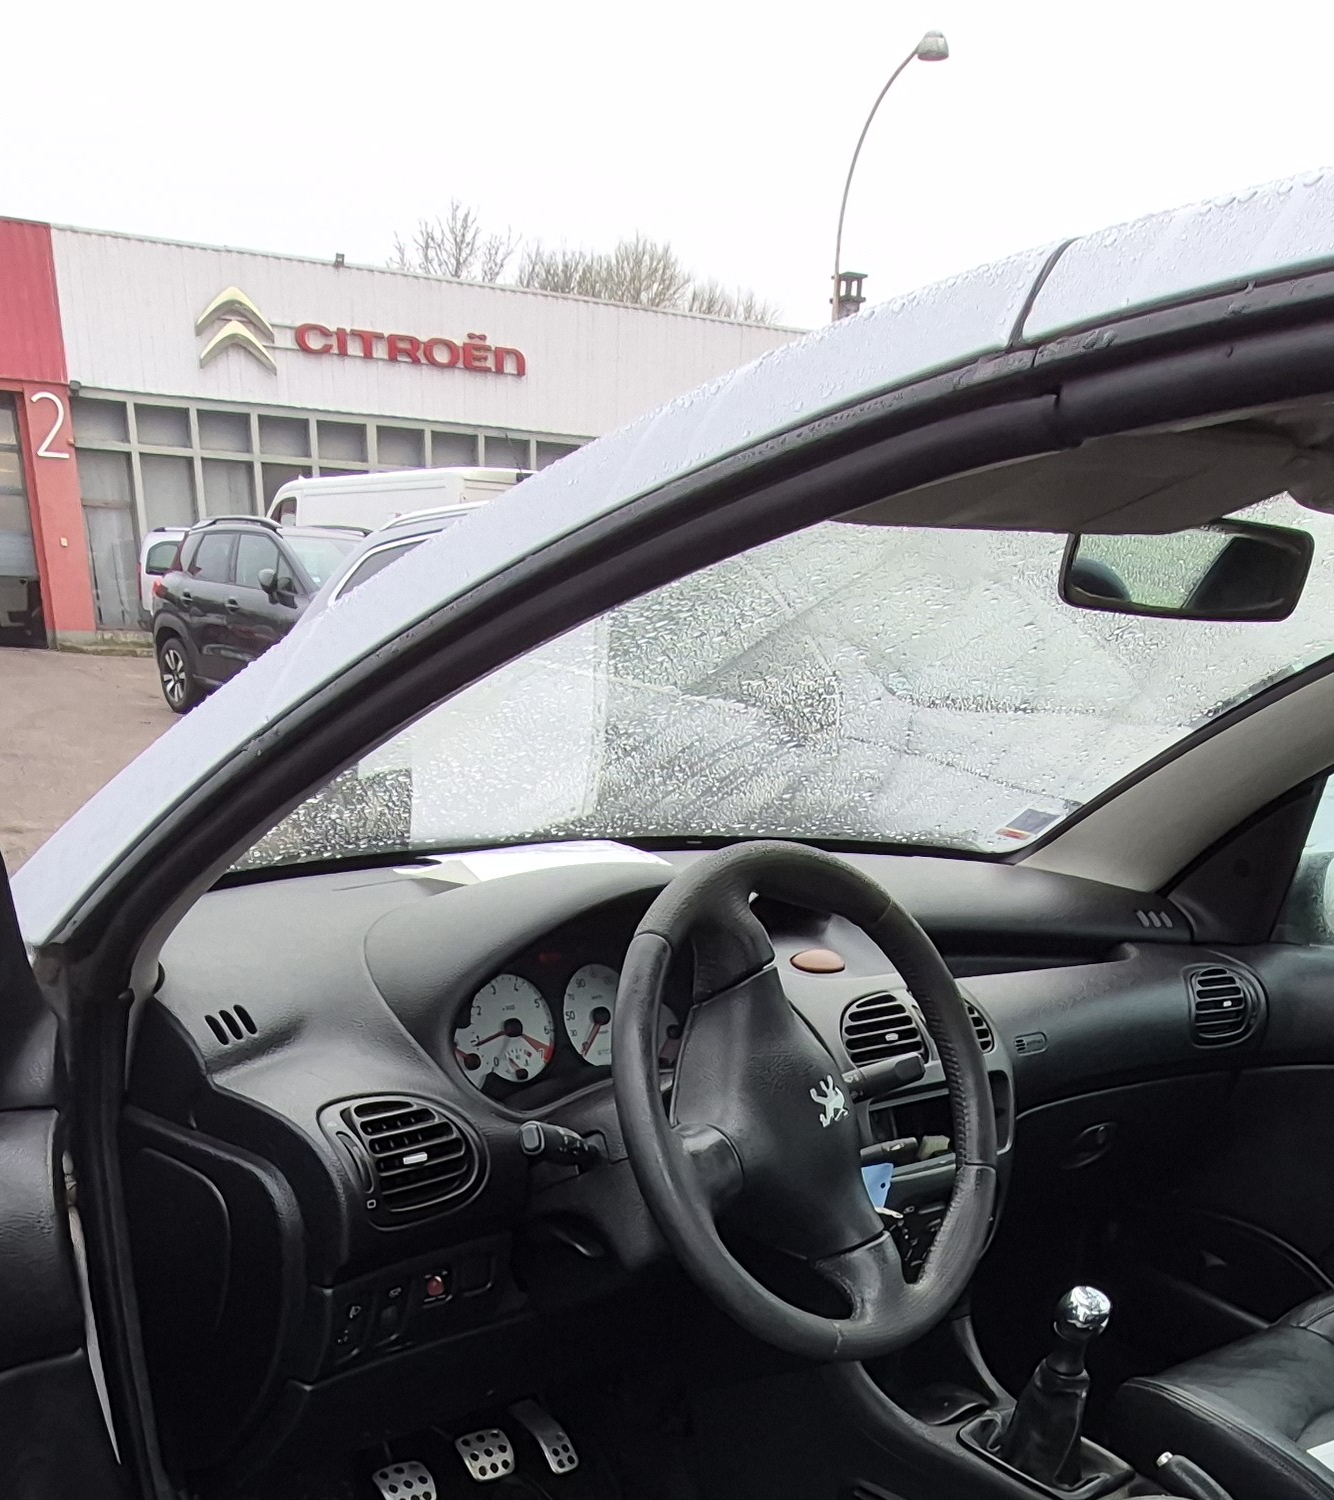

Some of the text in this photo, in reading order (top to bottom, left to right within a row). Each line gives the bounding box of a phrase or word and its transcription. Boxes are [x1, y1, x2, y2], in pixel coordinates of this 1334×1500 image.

[30, 391, 70, 459] 2
[534, 998, 541, 1008] 5
[476, 1005, 482, 1016] 2
[543, 1025, 550, 1035] 6
[493, 1056, 500, 1067] 0
